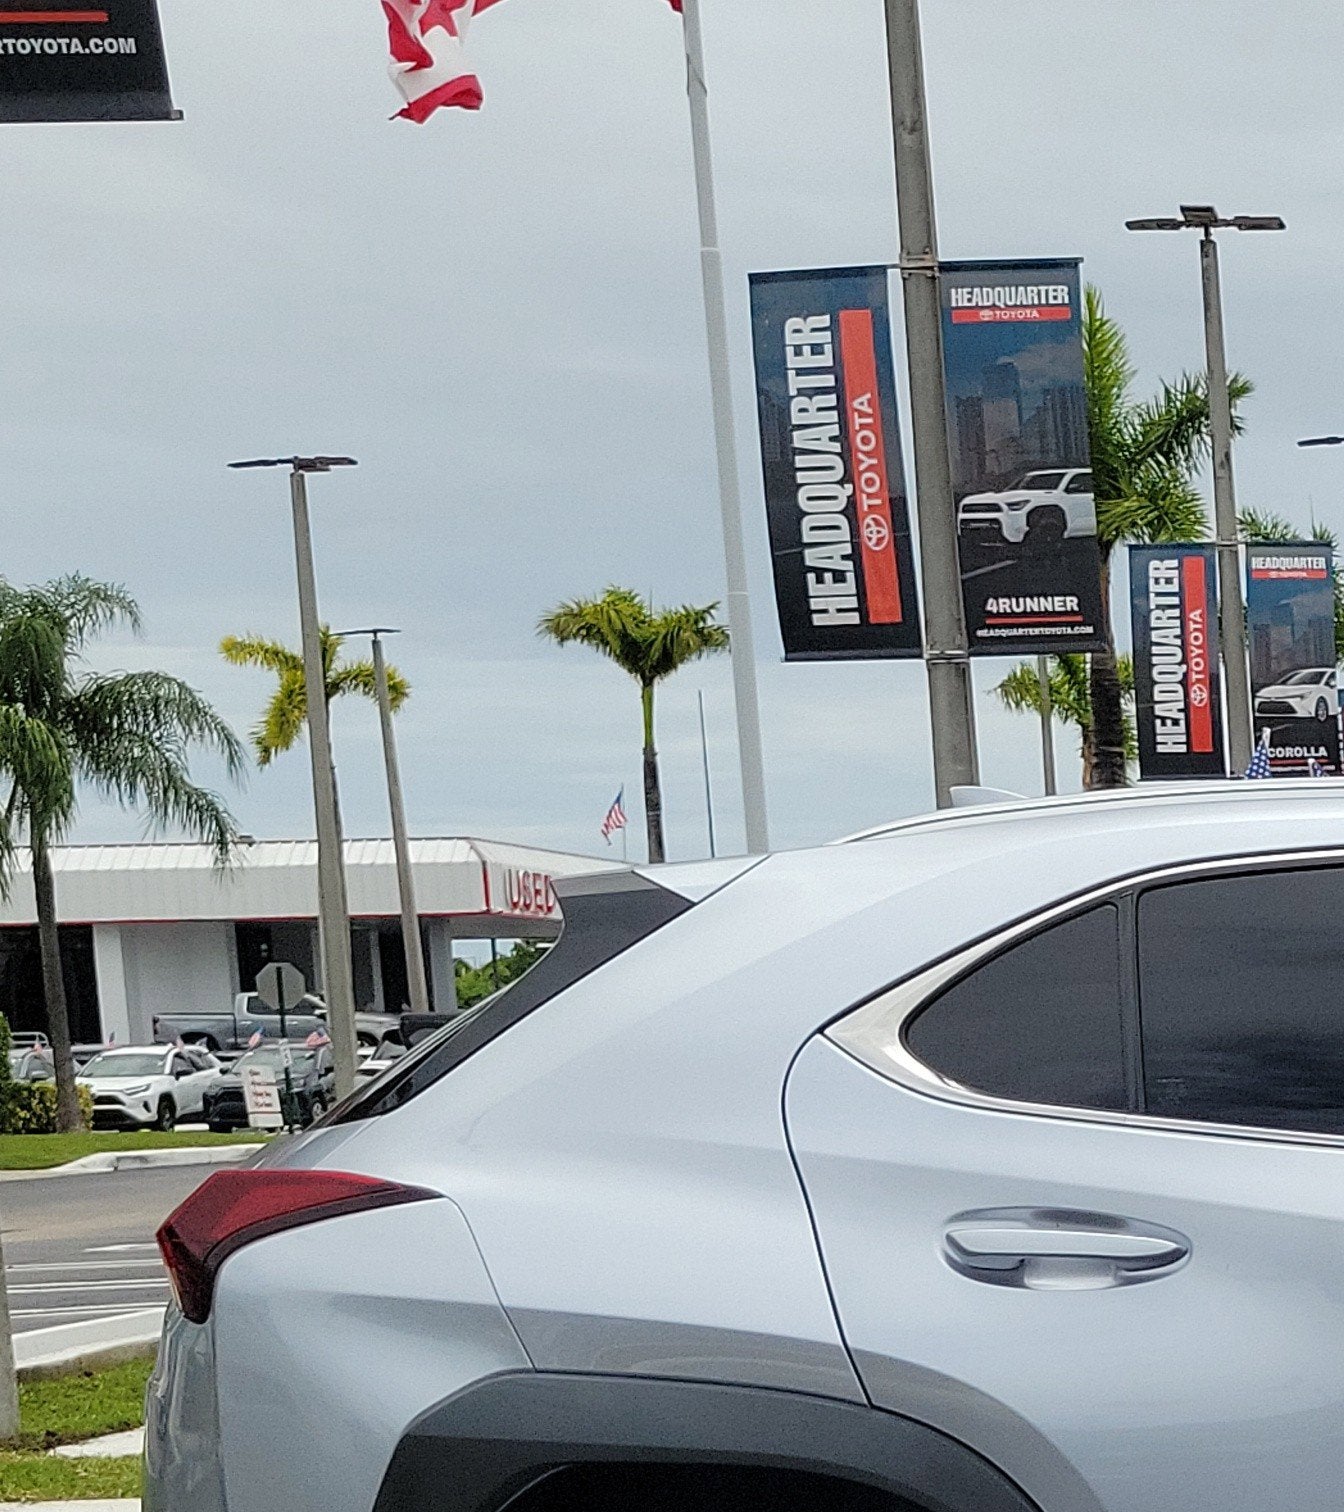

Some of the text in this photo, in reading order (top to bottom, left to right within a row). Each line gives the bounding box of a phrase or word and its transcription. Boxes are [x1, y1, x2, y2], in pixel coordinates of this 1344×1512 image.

[0, 37, 138, 54] TOYOTA.COM
[950, 285, 1069, 308] HEADQUARTER
[994, 309, 1040, 320] TOYOTA
[852, 392, 882, 512] TOYOTA
[784, 313, 861, 626] HEADQUARTER
[1251, 556, 1327, 570] HEADQUARTER
[984, 596, 1080, 614] 4RUNNER
[1148, 558, 1188, 753] HEADQUARTER
[1188, 609, 1206, 683] TOYOTA
[1268, 746, 1328, 758] COROLLA
[504, 868, 556, 915] USED
